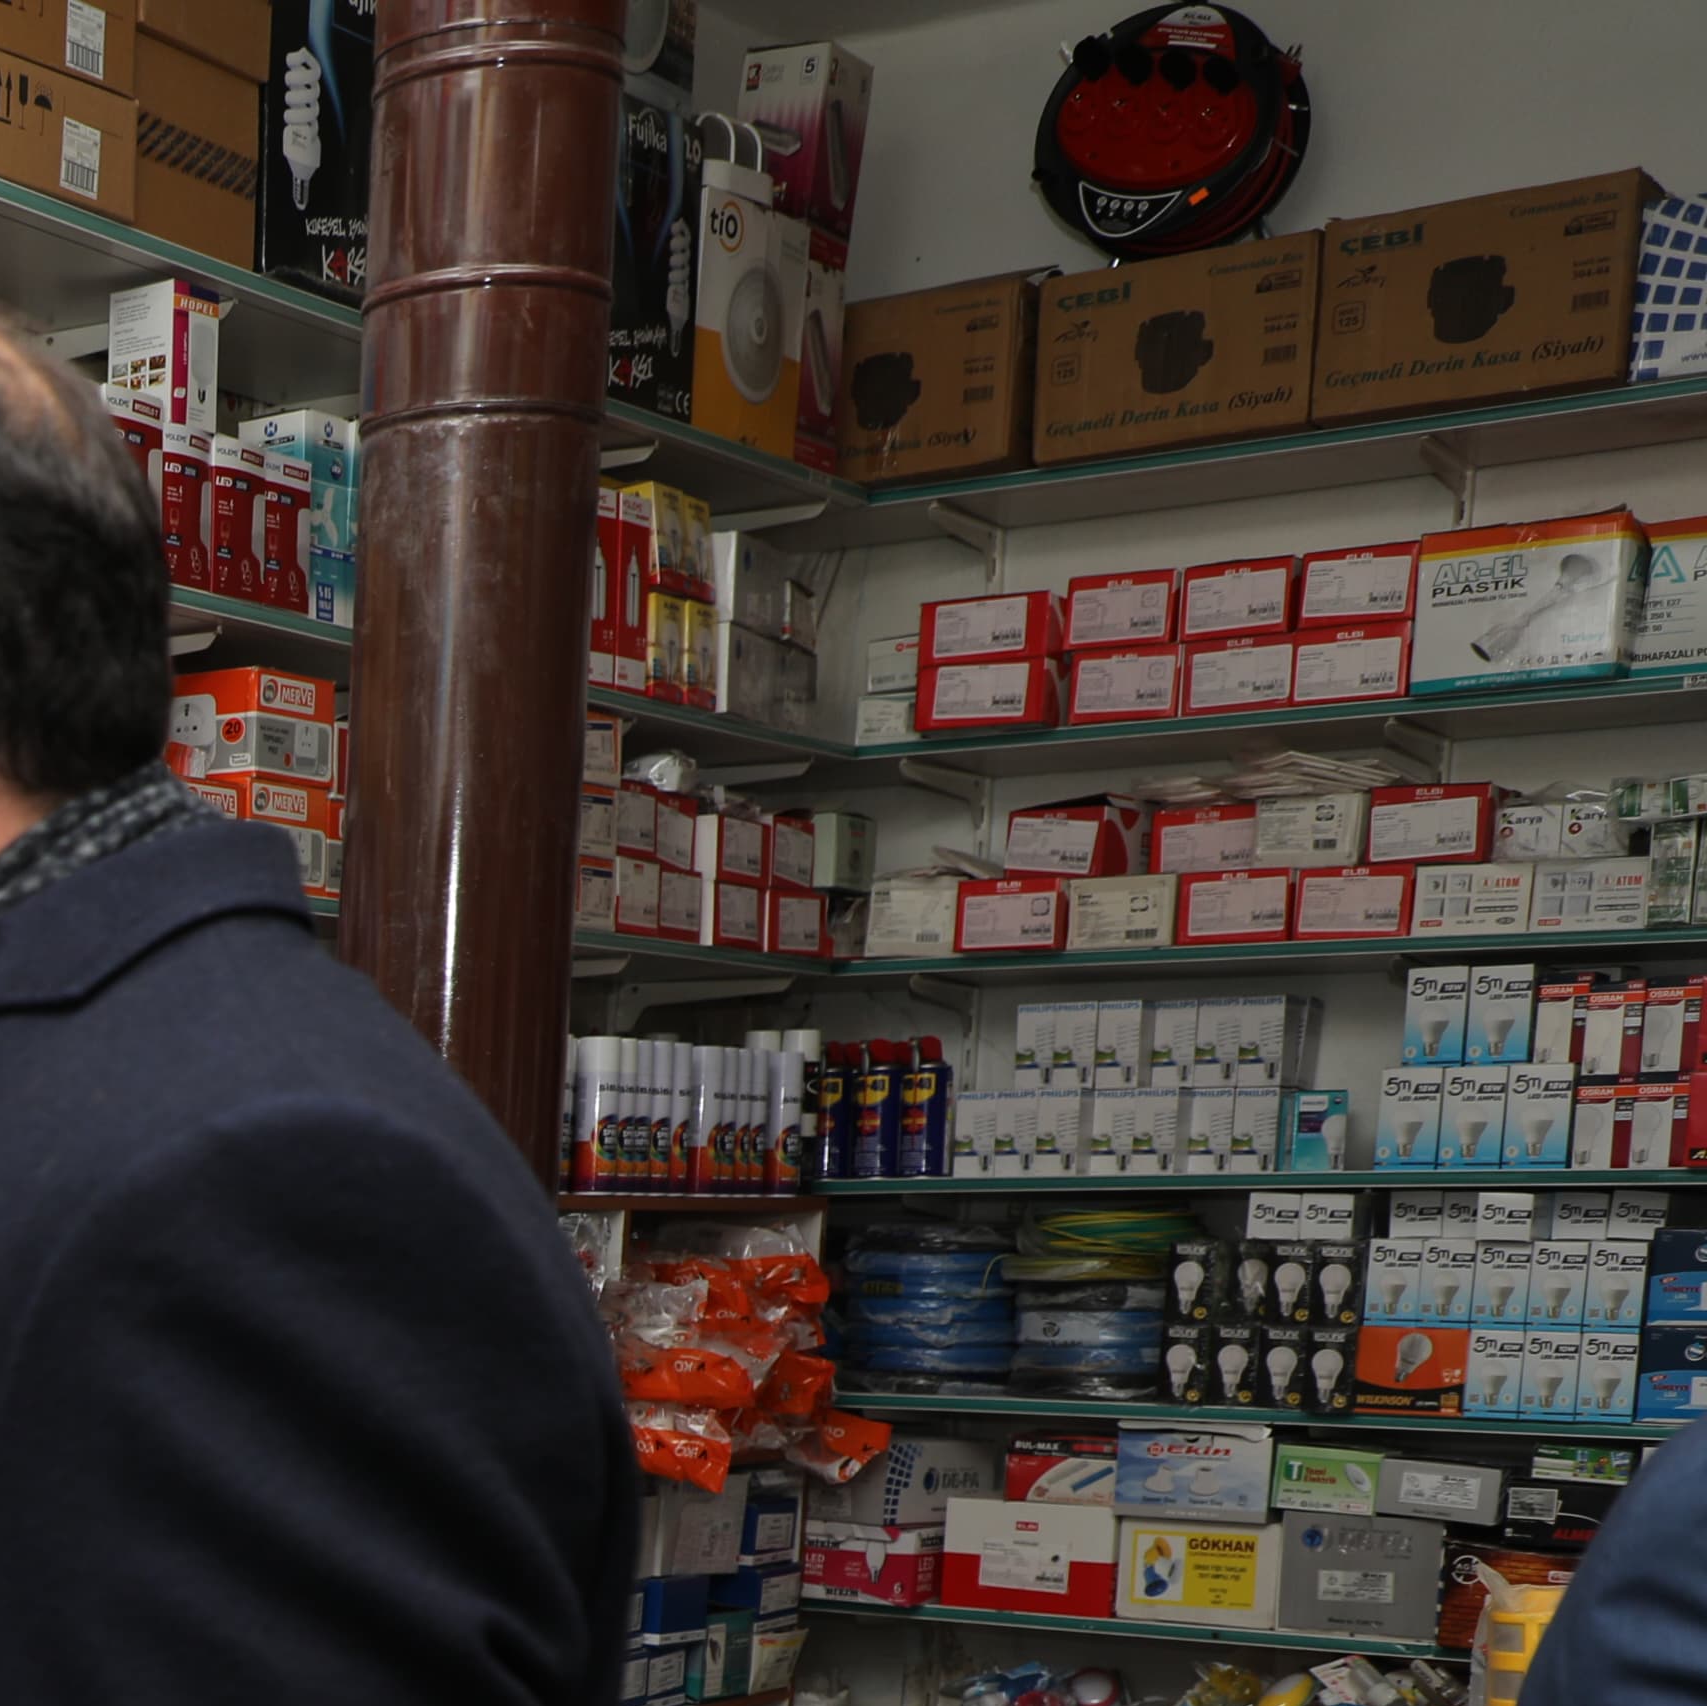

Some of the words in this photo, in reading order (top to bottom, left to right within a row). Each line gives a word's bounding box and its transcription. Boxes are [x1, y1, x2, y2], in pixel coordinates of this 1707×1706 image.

[1325, 362, 1402, 389] Geçmeli
[1408, 351, 1465, 376] Derin
[1472, 347, 1521, 367] Kasa
[223, 722, 242, 737] 20
[1188, 1536, 1255, 1553] GÖKHAN
